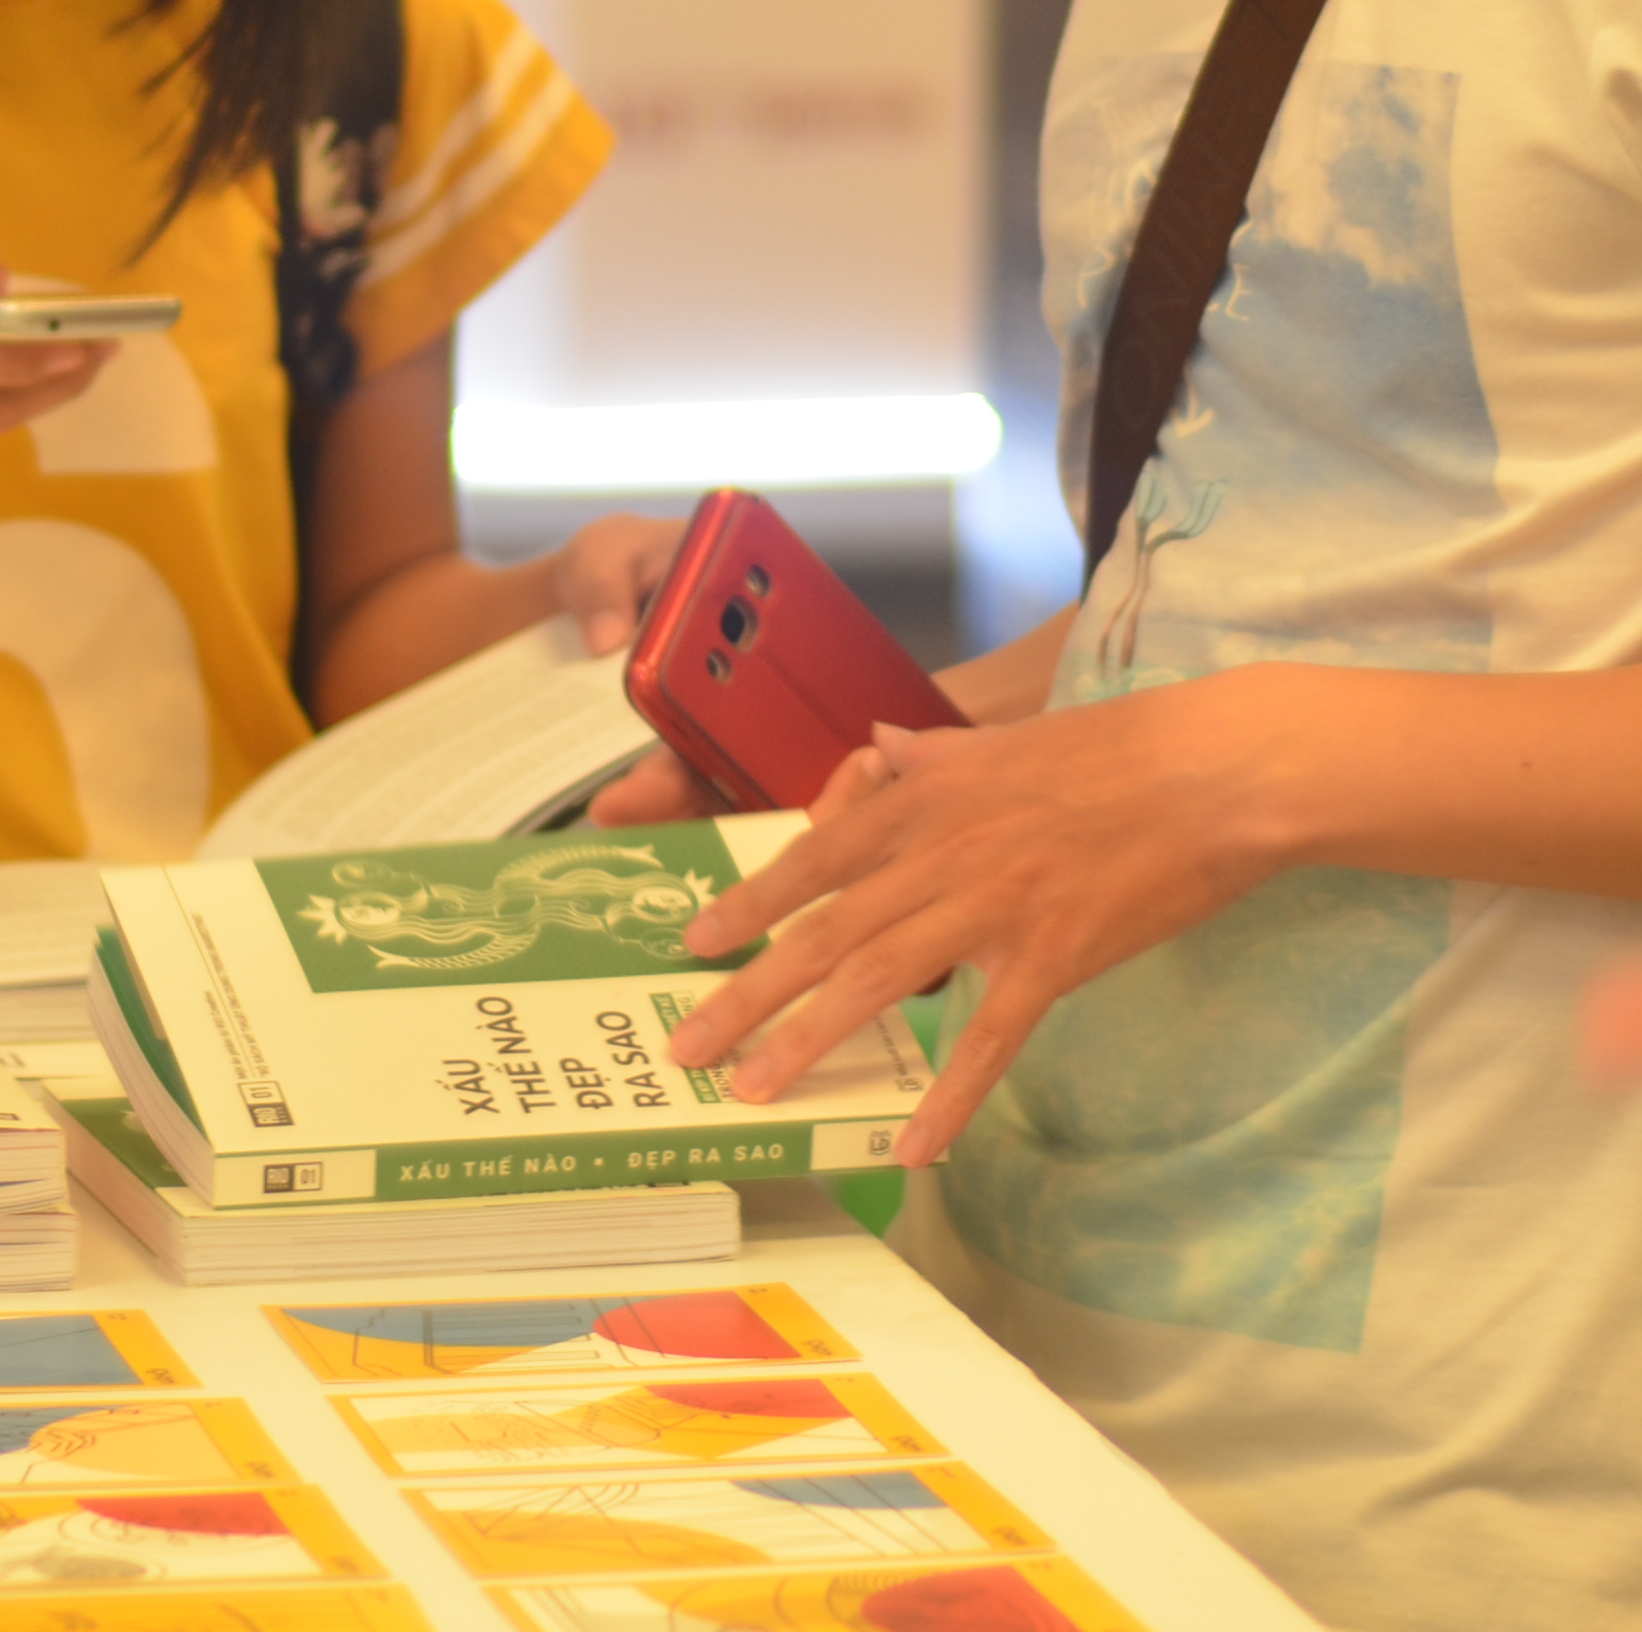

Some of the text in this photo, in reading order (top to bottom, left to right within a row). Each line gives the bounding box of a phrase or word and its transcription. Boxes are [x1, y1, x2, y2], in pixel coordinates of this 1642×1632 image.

[476, 996, 556, 1113] THẾ NÀO
[596, 1011, 671, 1108] RA SAO
[436, 1059, 500, 1115] XẤU
[559, 1058, 614, 1110] ĐẸP
[400, 1160, 451, 1181] XẤU
[463, 1155, 513, 1178] THẾ
[524, 1153, 578, 1175] NÀO
[628, 1150, 677, 1170] ĐẸP
[689, 1147, 722, 1165] RA
[734, 1143, 784, 1162] SAO
